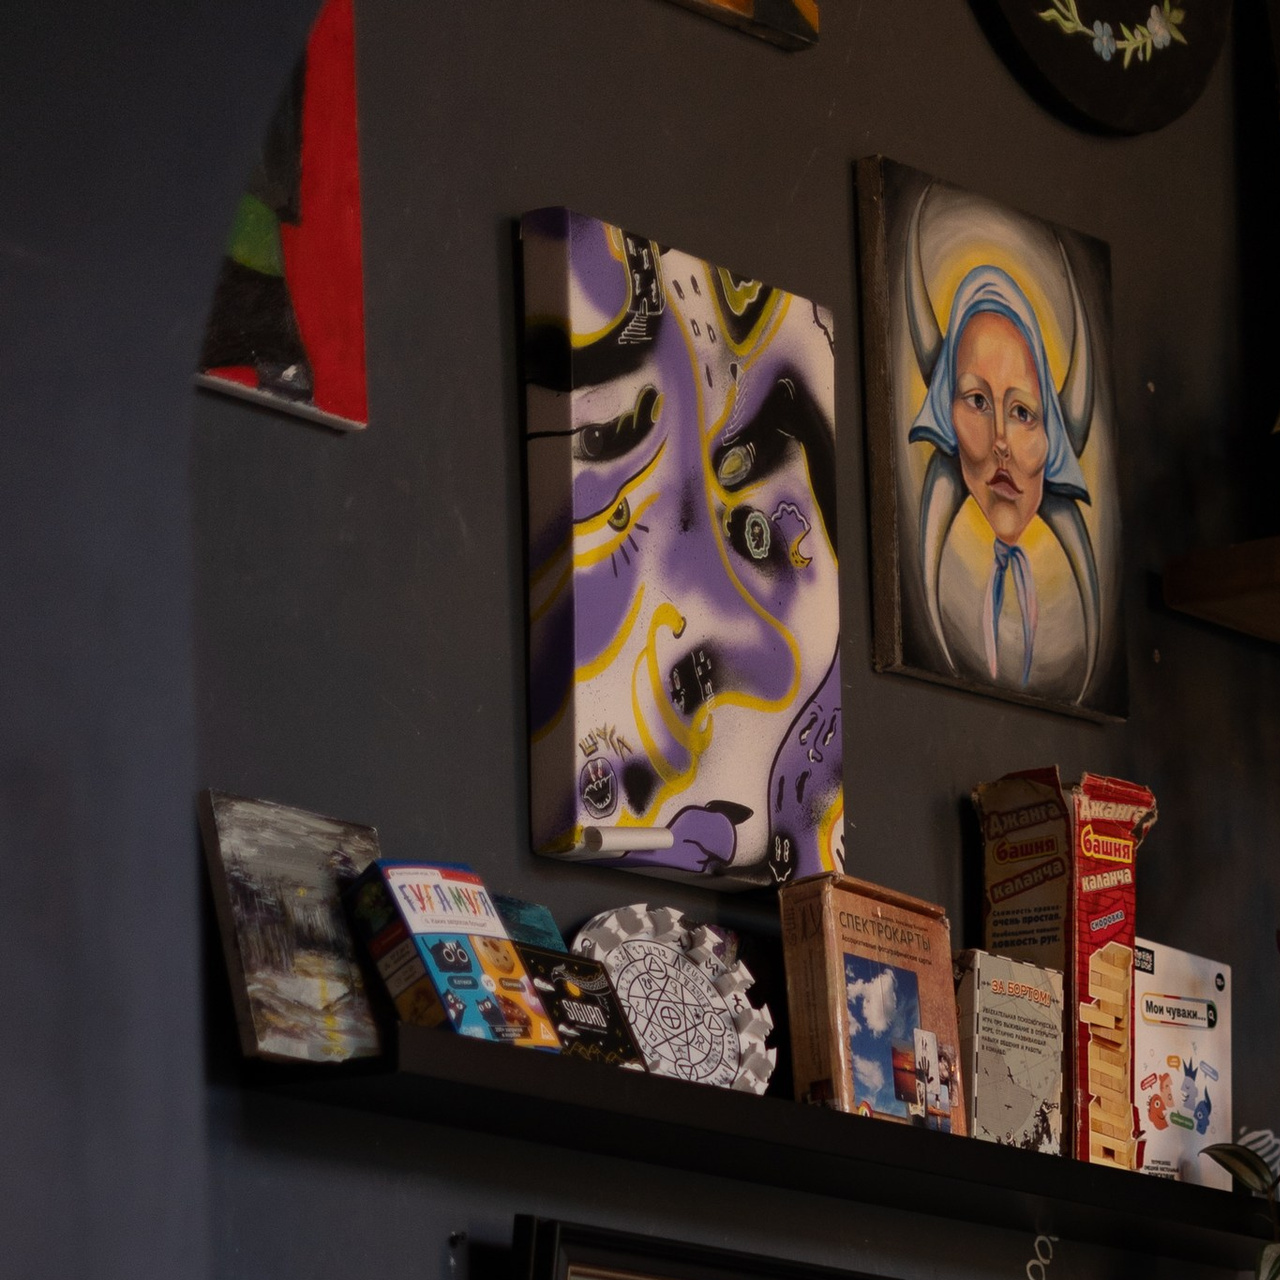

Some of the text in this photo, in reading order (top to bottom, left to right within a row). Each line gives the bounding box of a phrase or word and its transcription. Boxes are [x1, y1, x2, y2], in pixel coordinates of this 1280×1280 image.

[989, 802, 1061, 837] Джанга
[996, 838, 1056, 861] башня
[1083, 827, 1132, 861] башня
[993, 860, 1063, 900] каланча
[1082, 868, 1133, 893] каланча
[839, 911, 931, 952] СПЕКТРОКАРТЫ
[992, 912, 1061, 927] очень простая.
[992, 934, 1060, 948] ловкость рук.
[991, 979, 1052, 1008] ЗА БОРТОМ!
[1145, 1000, 1206, 1020] Мои чуваки...
